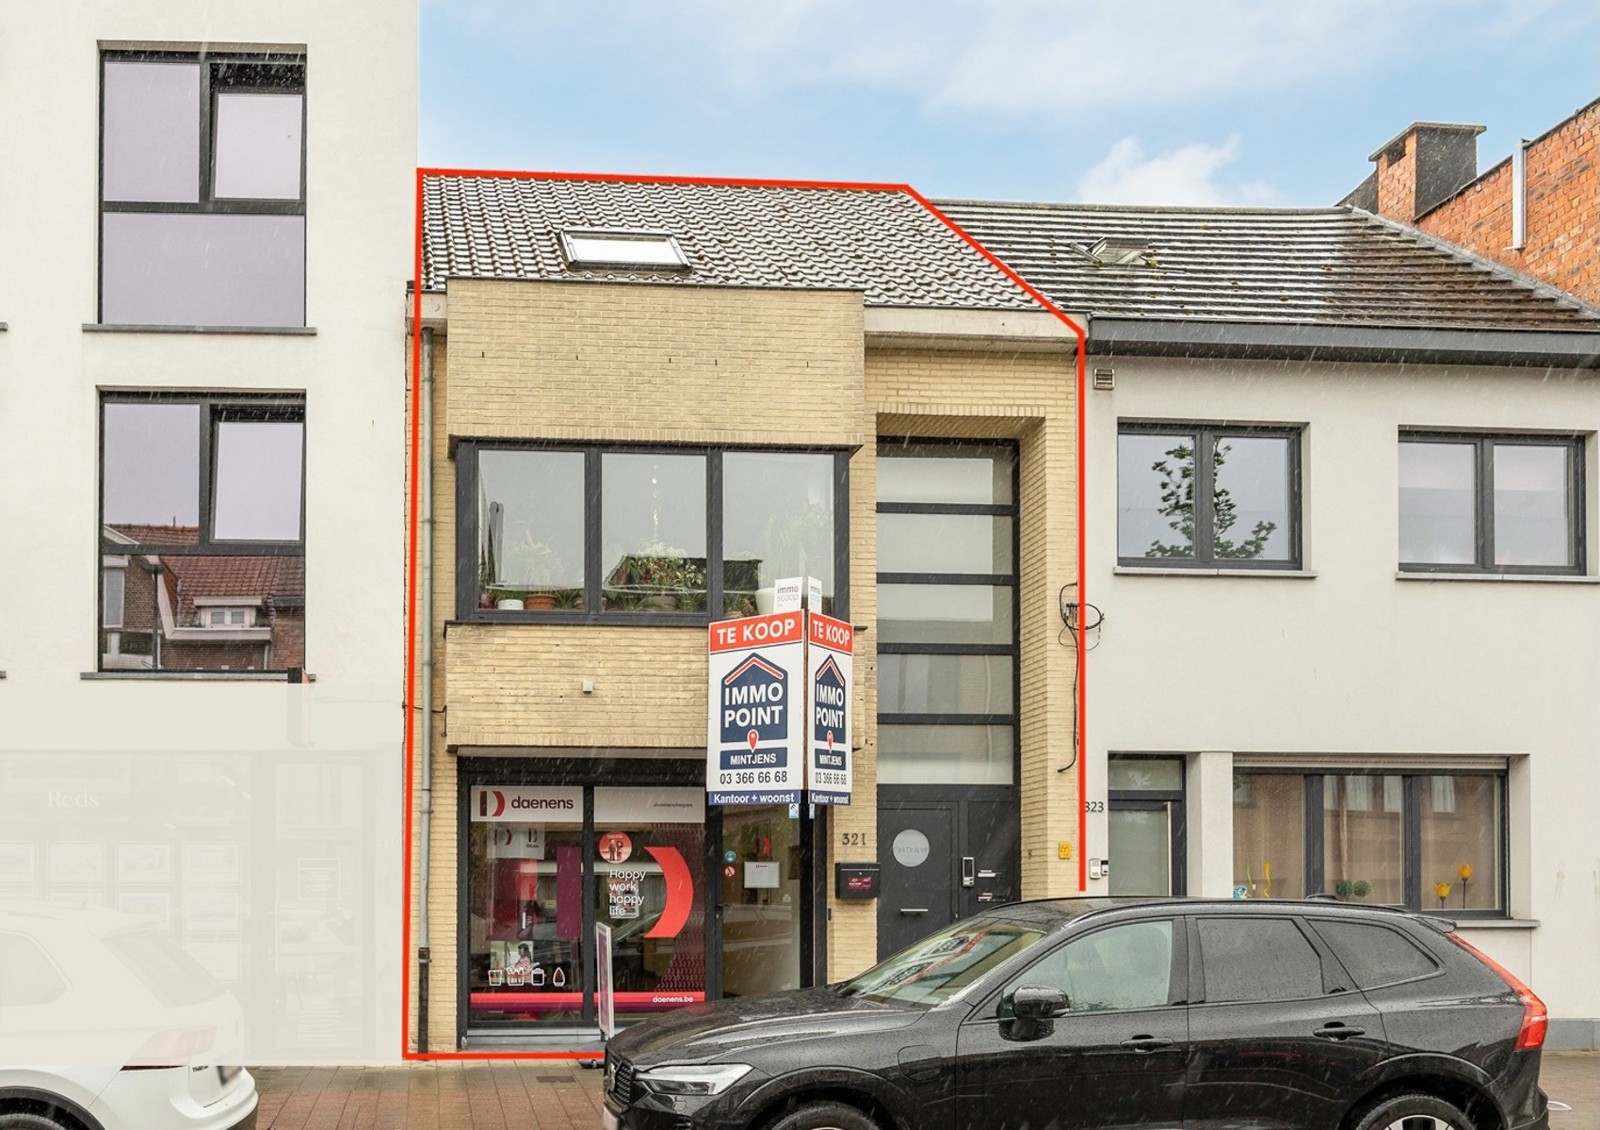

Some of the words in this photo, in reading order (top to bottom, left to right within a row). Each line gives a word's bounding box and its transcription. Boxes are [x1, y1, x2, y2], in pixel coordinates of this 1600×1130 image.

[777, 585, 799, 594] immo
[717, 627, 737, 645] TE
[742, 618, 796, 642] KOOP
[813, 620, 825, 638] TE
[826, 625, 850, 647] KOOP
[724, 682, 784, 706] IMMO
[816, 683, 844, 706] IMMO
[724, 705, 784, 728] POINT
[816, 706, 844, 729] POINT
[730, 753, 777, 765] MINTJENS
[720, 772, 732, 784] 03
[735, 771, 755, 784] 366
[758, 771, 771, 783] 66
[774, 770, 788, 783] 68
[511, 795, 574, 810] daenens
[713, 793, 750, 804] Kantoor
[759, 792, 795, 803] woonst
[1084, 801, 1105, 813] 323
[841, 832, 867, 846] 321
[609, 869, 646, 882] Happy
[609, 881, 639, 892] work,
[609, 893, 645, 906] happy
[609, 905, 626, 916] life
[652, 995, 694, 1003] daenens.be
